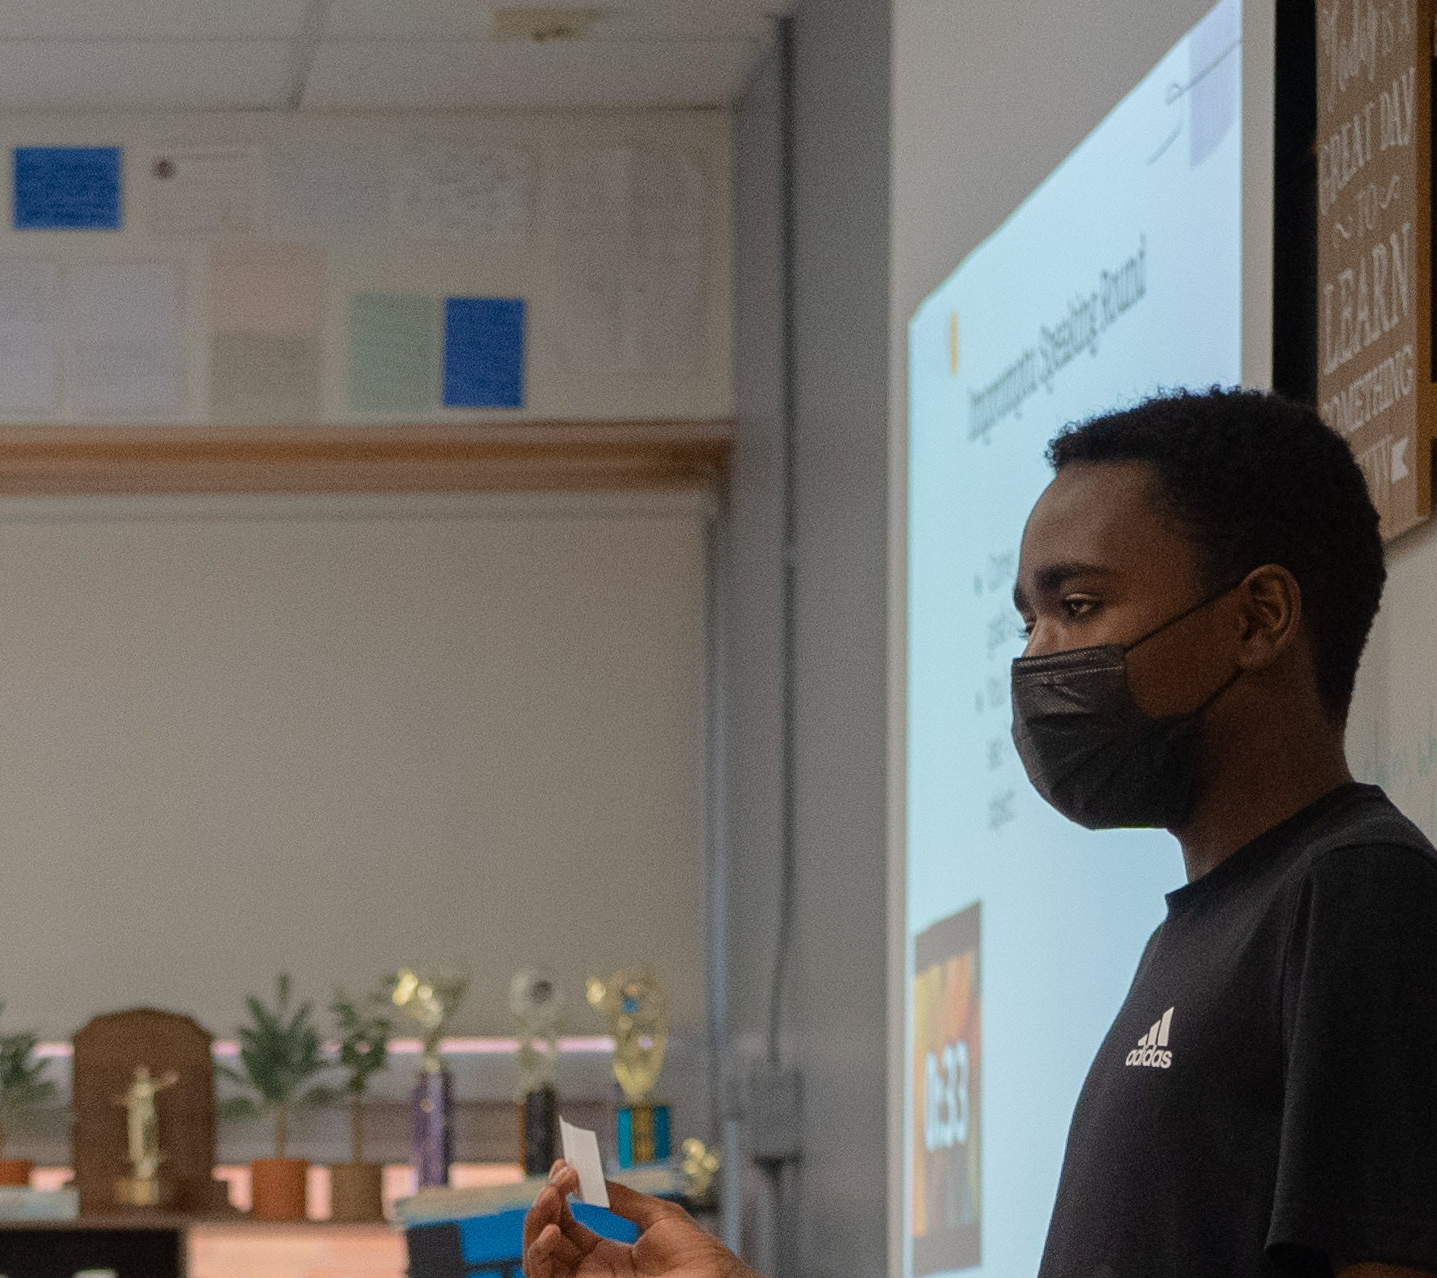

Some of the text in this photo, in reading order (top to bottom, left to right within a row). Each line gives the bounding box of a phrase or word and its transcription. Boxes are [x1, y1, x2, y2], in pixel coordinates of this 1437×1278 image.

[1320, 66, 1416, 217] GREAT DAY
[1356, 183, 1379, 238] TO
[1037, 287, 1100, 382] Speaking
[1099, 233, 1147, 335] Round
[1323, 222, 1411, 376] LEARN
[1125, 1044, 1173, 1069] adidas
